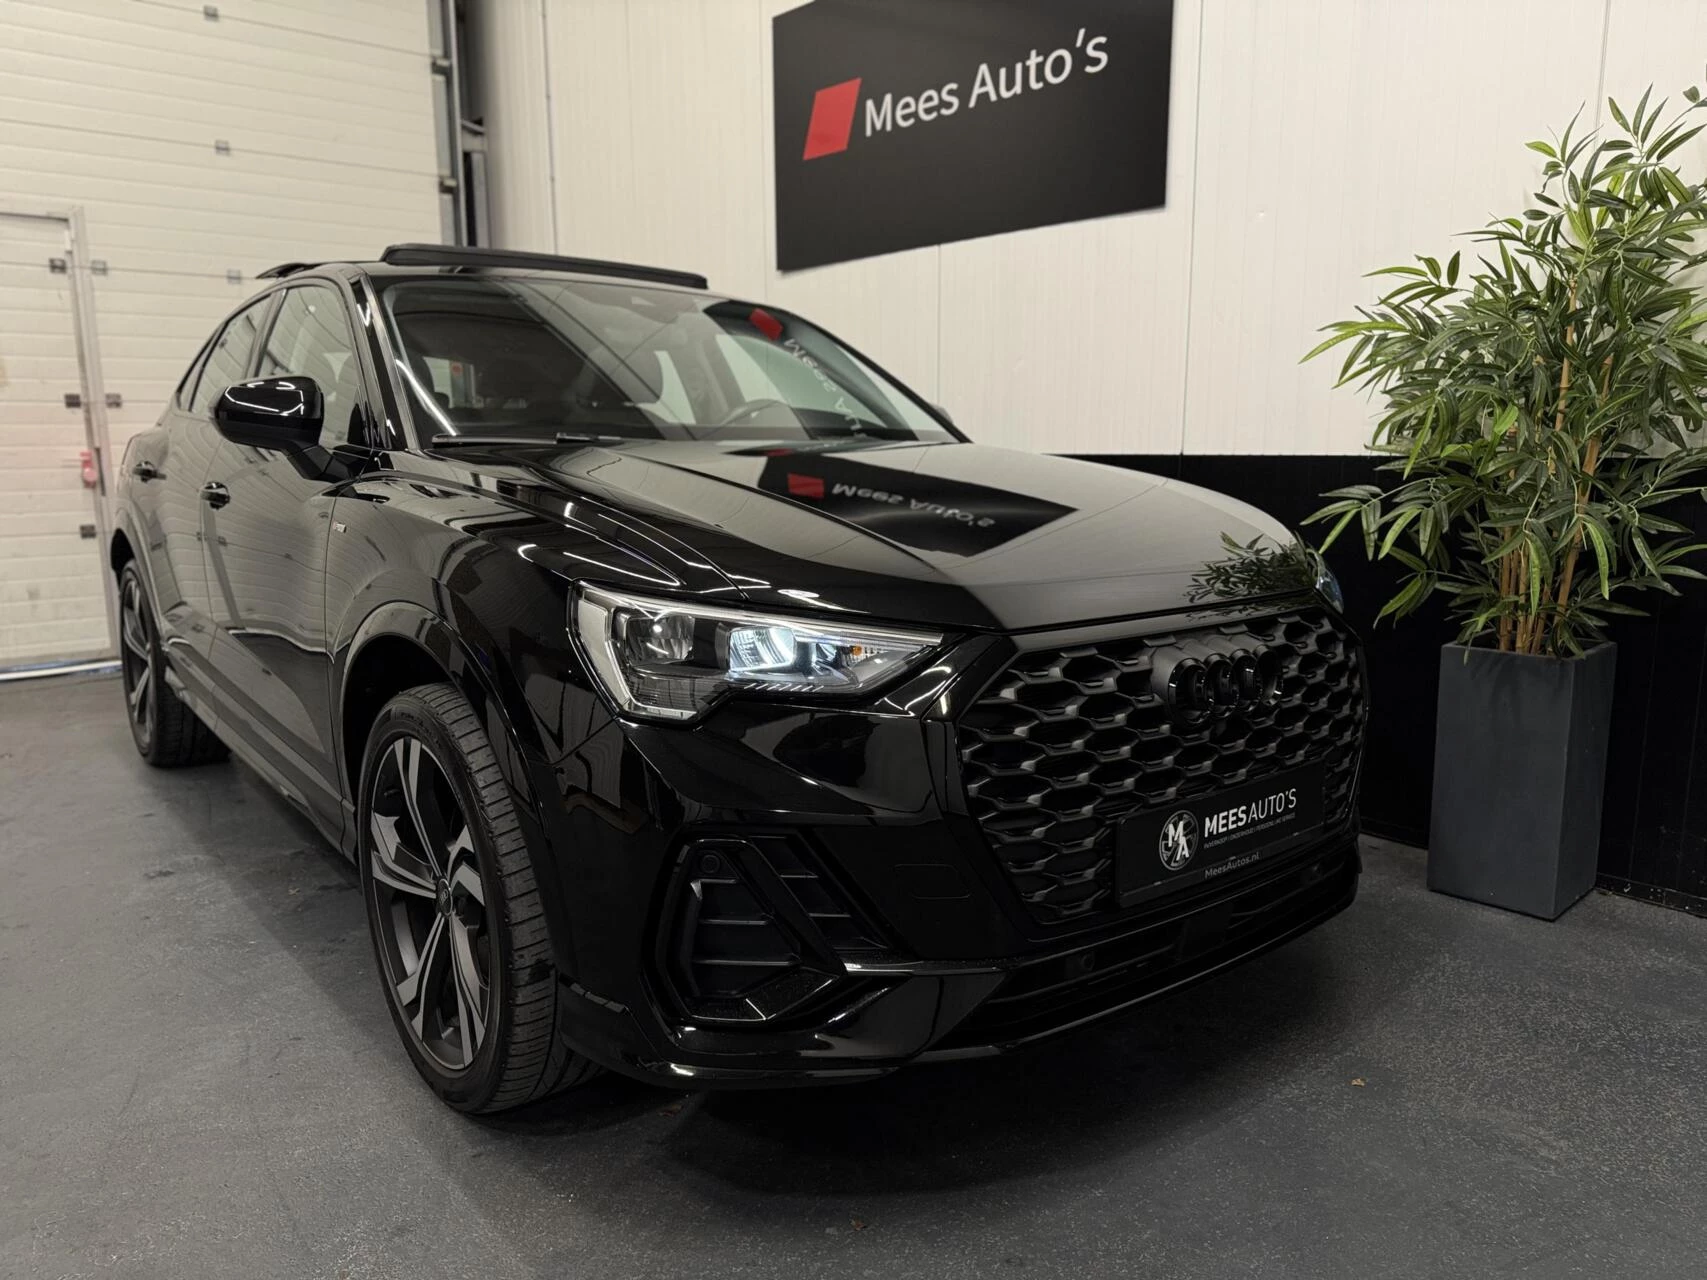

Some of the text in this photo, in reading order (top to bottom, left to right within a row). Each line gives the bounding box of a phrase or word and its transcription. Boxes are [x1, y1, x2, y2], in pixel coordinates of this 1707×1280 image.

[864, 28, 1110, 137] Mees Auto's
[1205, 852, 1260, 880] MeesAutos.nl
